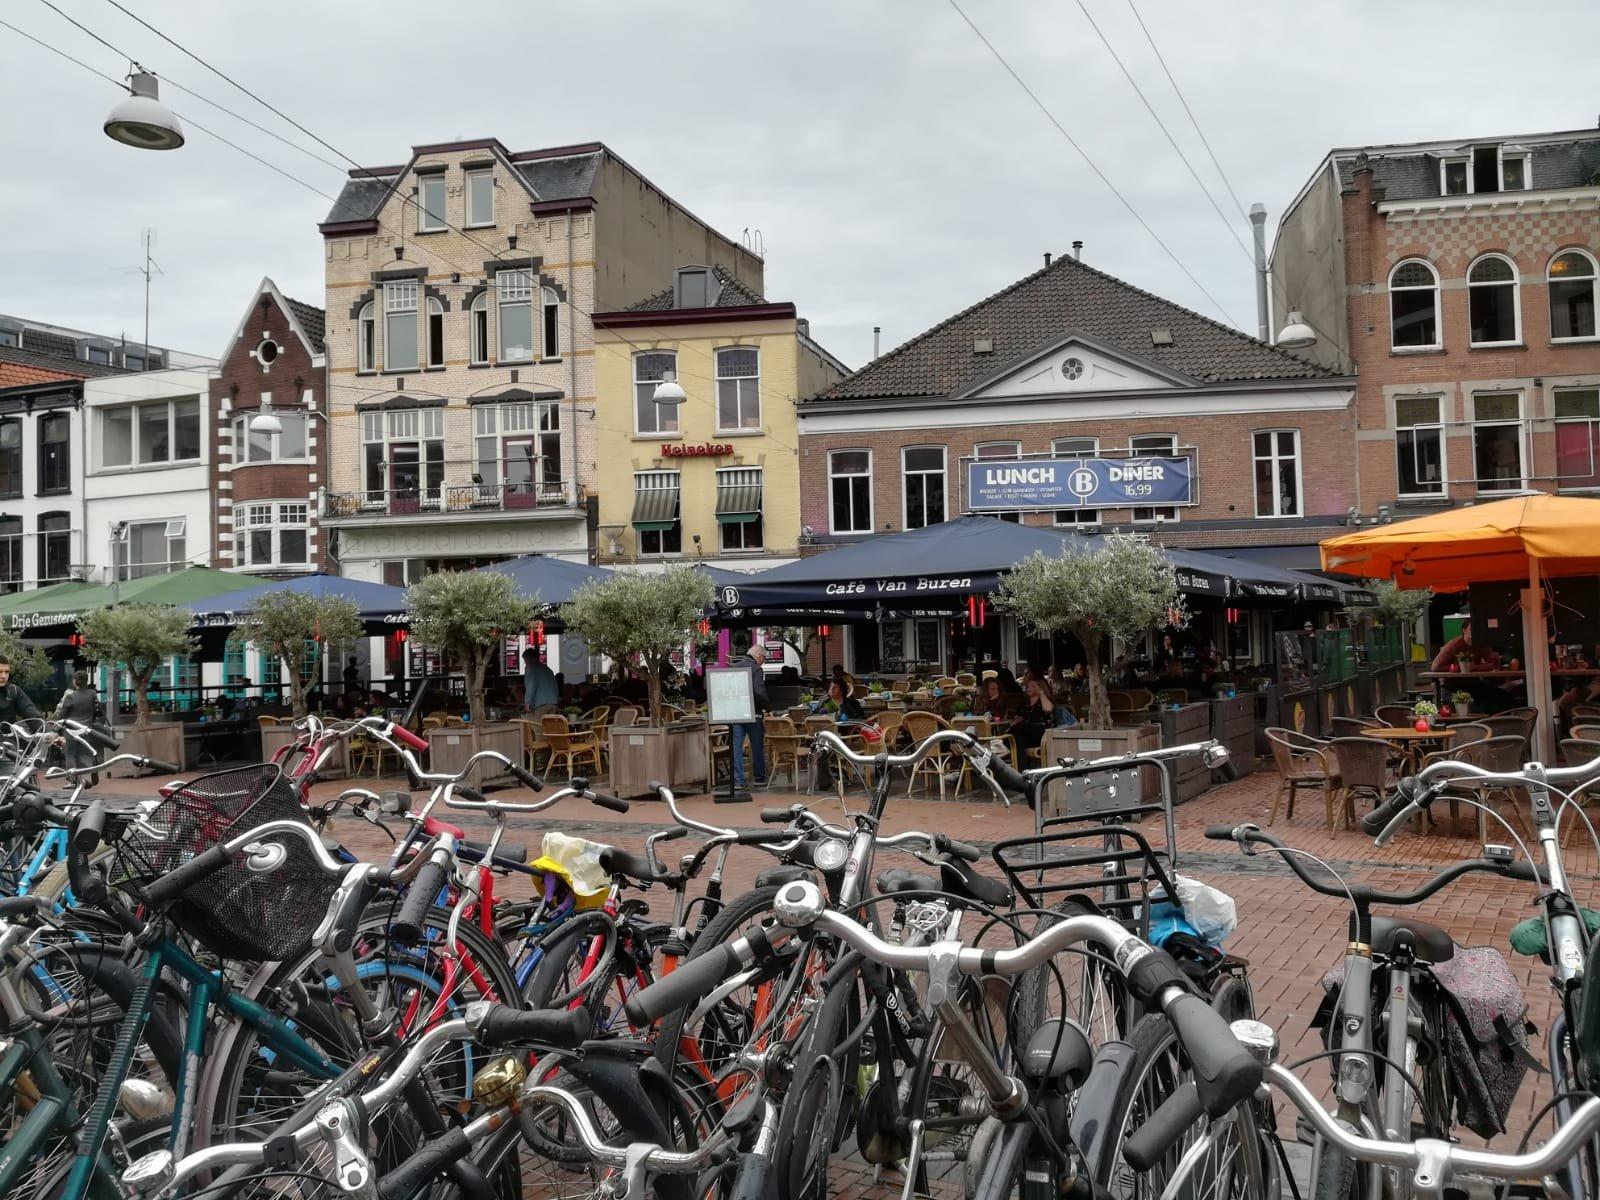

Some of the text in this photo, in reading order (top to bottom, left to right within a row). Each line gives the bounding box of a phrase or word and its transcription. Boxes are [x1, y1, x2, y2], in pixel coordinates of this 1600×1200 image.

[661, 442, 734, 458] Heineken
[986, 467, 1055, 485] LUNCH
[1075, 472, 1093, 492] B
[1109, 466, 1164, 482] DINER
[1124, 484, 1152, 496] 16,99
[826, 578, 971, 595] Café Van Buren
[12, 613, 77, 629] Drie Gezusters
